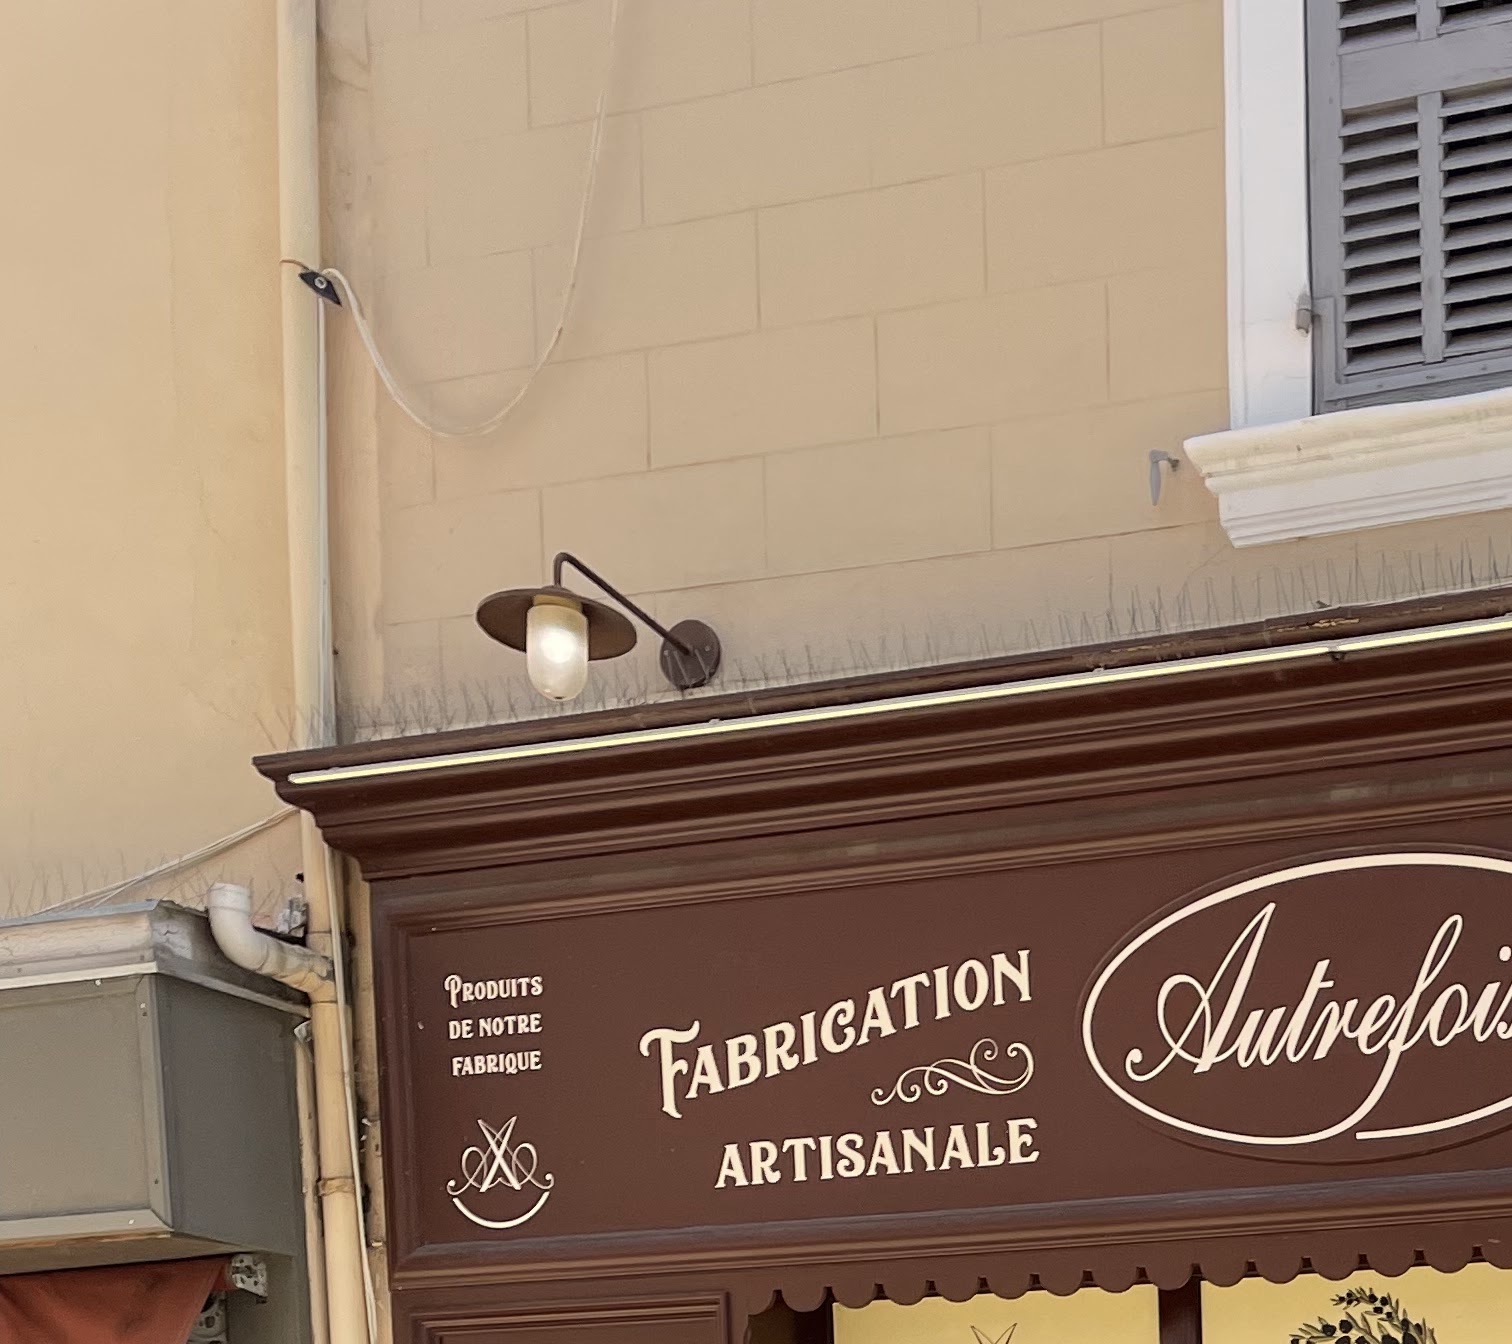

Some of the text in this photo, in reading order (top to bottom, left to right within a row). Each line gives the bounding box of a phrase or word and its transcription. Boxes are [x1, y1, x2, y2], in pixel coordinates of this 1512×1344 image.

[444, 974, 543, 1009] PRODUITS
[448, 1013, 543, 1040] DE NOTRE
[639, 949, 1033, 1119] FABRICATION
[452, 1050, 543, 1077] FABRIQUE
[714, 1117, 1040, 1189] ARTISANALE
